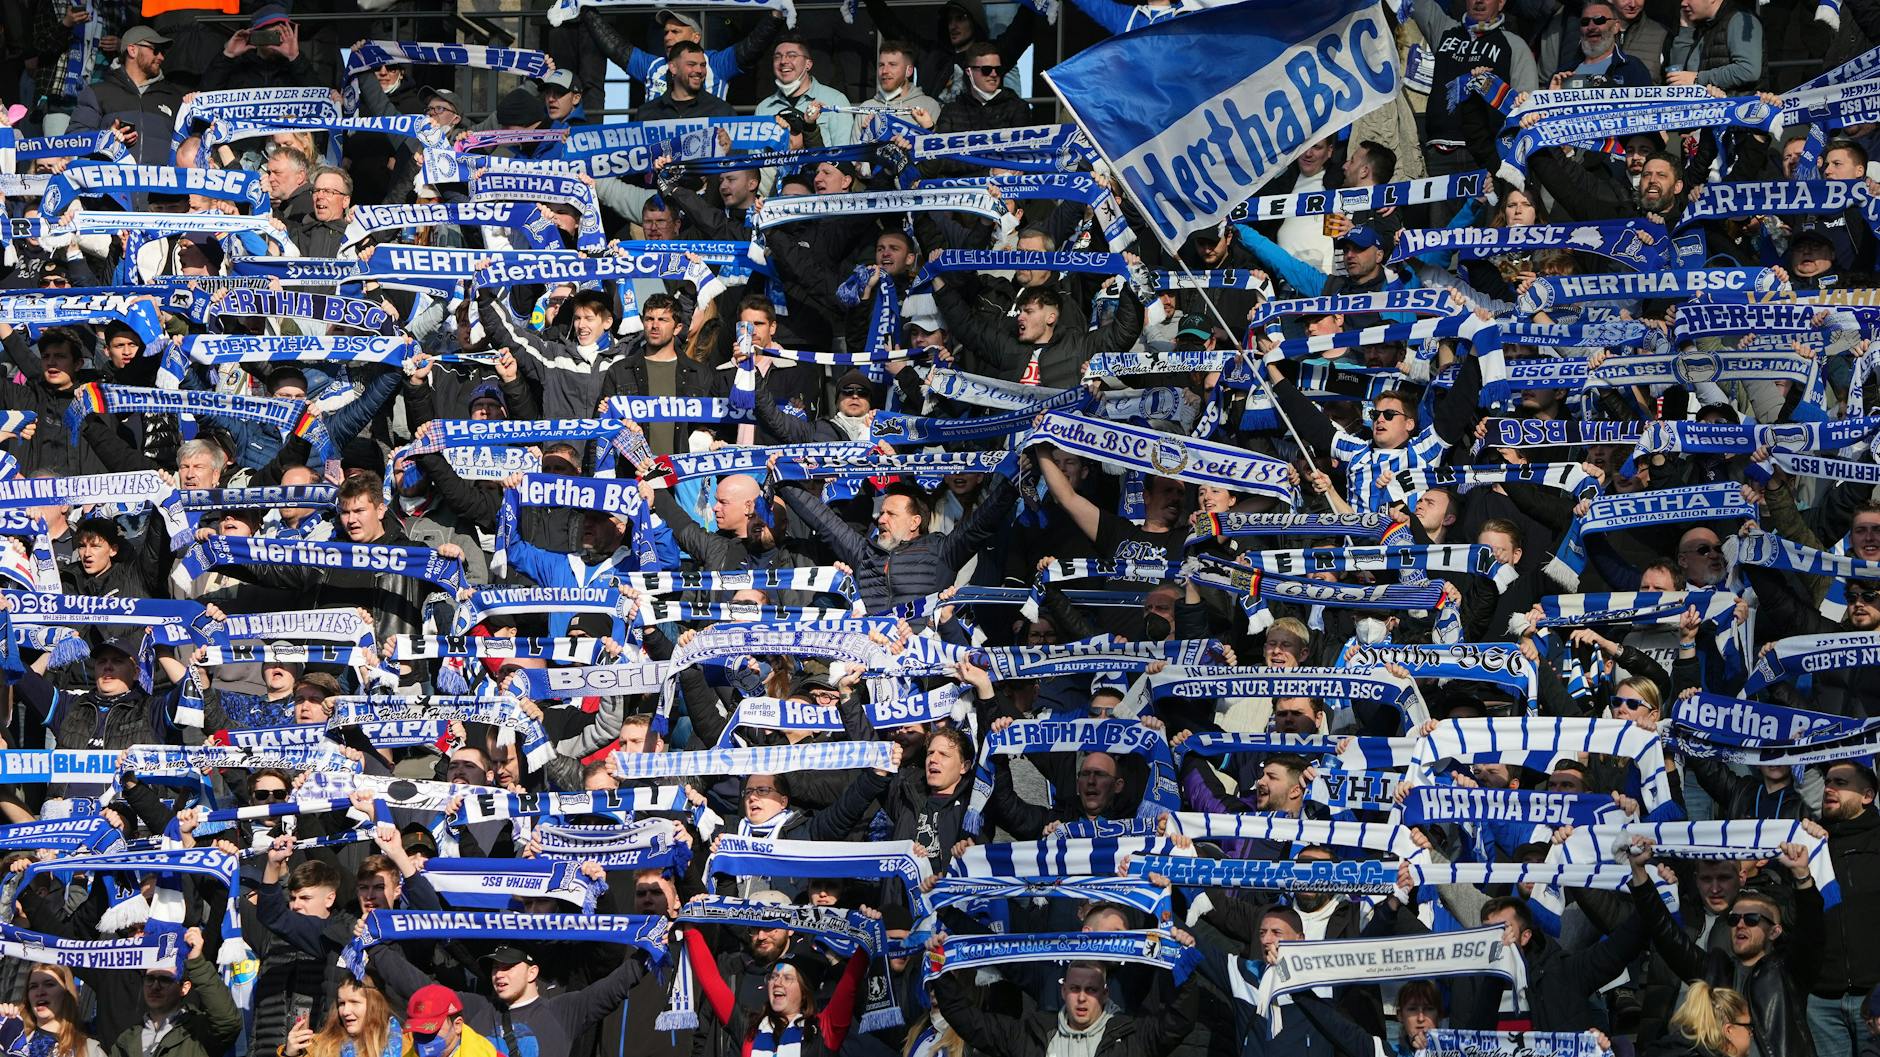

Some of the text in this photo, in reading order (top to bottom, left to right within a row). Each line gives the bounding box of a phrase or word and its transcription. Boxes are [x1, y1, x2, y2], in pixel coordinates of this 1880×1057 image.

[1439, 36, 1500, 62] BERLIN
[207, 89, 298, 105] BERLIN AN DER
[1533, 94, 1550, 106] IN
[1554, 90, 1605, 104] BERLIN
[1610, 88, 1632, 100] AN
[1635, 87, 1662, 99] DER
[223, 107, 255, 120] NUR
[258, 103, 316, 118] HERTHA
[1538, 108, 1727, 140] HERTHA IST EINE RELIGION
[46, 136, 92, 150] Verein
[567, 133, 602, 153] ICH
[603, 126, 644, 149] BIN
[923, 127, 1050, 152] BERLIN
[591, 146, 649, 178] BSC
[67, 164, 246, 194] HERTHA BSC
[477, 176, 555, 192] HERTHA
[1073, 176, 1094, 193] 92
[920, 191, 993, 212] BERLIN
[355, 201, 515, 231] Hertha BSC
[1405, 224, 1565, 251] Hertha BSC
[488, 254, 658, 283] Hertha BSC
[940, 250, 1109, 267] HERTHA BSC
[1560, 269, 1747, 298] HERTHA BSC
[210, 288, 388, 330] HERTHA BSC
[1385, 288, 1453, 313] BSC
[1682, 304, 1816, 334] HERTHA
[202, 335, 390, 356] HERTHA BSC
[1520, 335, 1560, 345] BERLIN
[1512, 366, 1555, 378] BSC
[1632, 357, 1762, 376] BSC FÜR
[117, 389, 290, 421] Hertha BSC Berlin
[611, 395, 706, 420] Hertha
[446, 418, 623, 436] Hertha BSC
[472, 432, 508, 440] EVERY
[1500, 418, 1569, 446] BSC
[1686, 424, 1744, 433] Nur nach
[1034, 415, 1098, 446] Hertha
[1101, 430, 1148, 458] BSC
[1191, 460, 1238, 478] seit
[1685, 434, 1749, 446] Hause
[476, 469, 502, 477] EINEN
[1791, 457, 1820, 475] BSC
[35, 479, 51, 499] IN
[222, 486, 338, 502] BERLIN
[1605, 509, 1709, 526] OLYMPIASTADION
[246, 537, 408, 572] Hertha BSC
[481, 587, 609, 605] OLYMPIASTADION
[228, 618, 248, 635] IN
[1054, 662, 1138, 673] HAUPTSTADT
[1802, 649, 1857, 673] GIBT'S
[1172, 680, 1385, 701] GIBT'S NUR HERTHA BSC
[354, 706, 491, 722] nur Hertha nur
[750, 702, 771, 711] Berlin
[758, 710, 776, 718] 1892
[874, 695, 925, 722] BSC
[1678, 695, 1779, 741] Hertha
[362, 720, 439, 738] PAPA
[990, 719, 1159, 751] HERTHA BSC
[6, 752, 50, 774] BIN
[54, 753, 118, 774] BLAU
[165, 760, 187, 769] nur
[249, 756, 293, 770] Hertha
[1420, 787, 1578, 825] HERTHA BSC
[8, 818, 101, 838] FREUNDE
[607, 833, 639, 846] BSC
[752, 842, 774, 853] BSC
[182, 850, 239, 877] BSC
[481, 876, 543, 890] HERTHA BSC
[392, 912, 630, 933] EINMAL HERTHANER
[952, 934, 1137, 961] Karlsruhe & Berlin
[1451, 940, 1487, 959] BSC
[57, 949, 143, 968] HERTHA BSC
